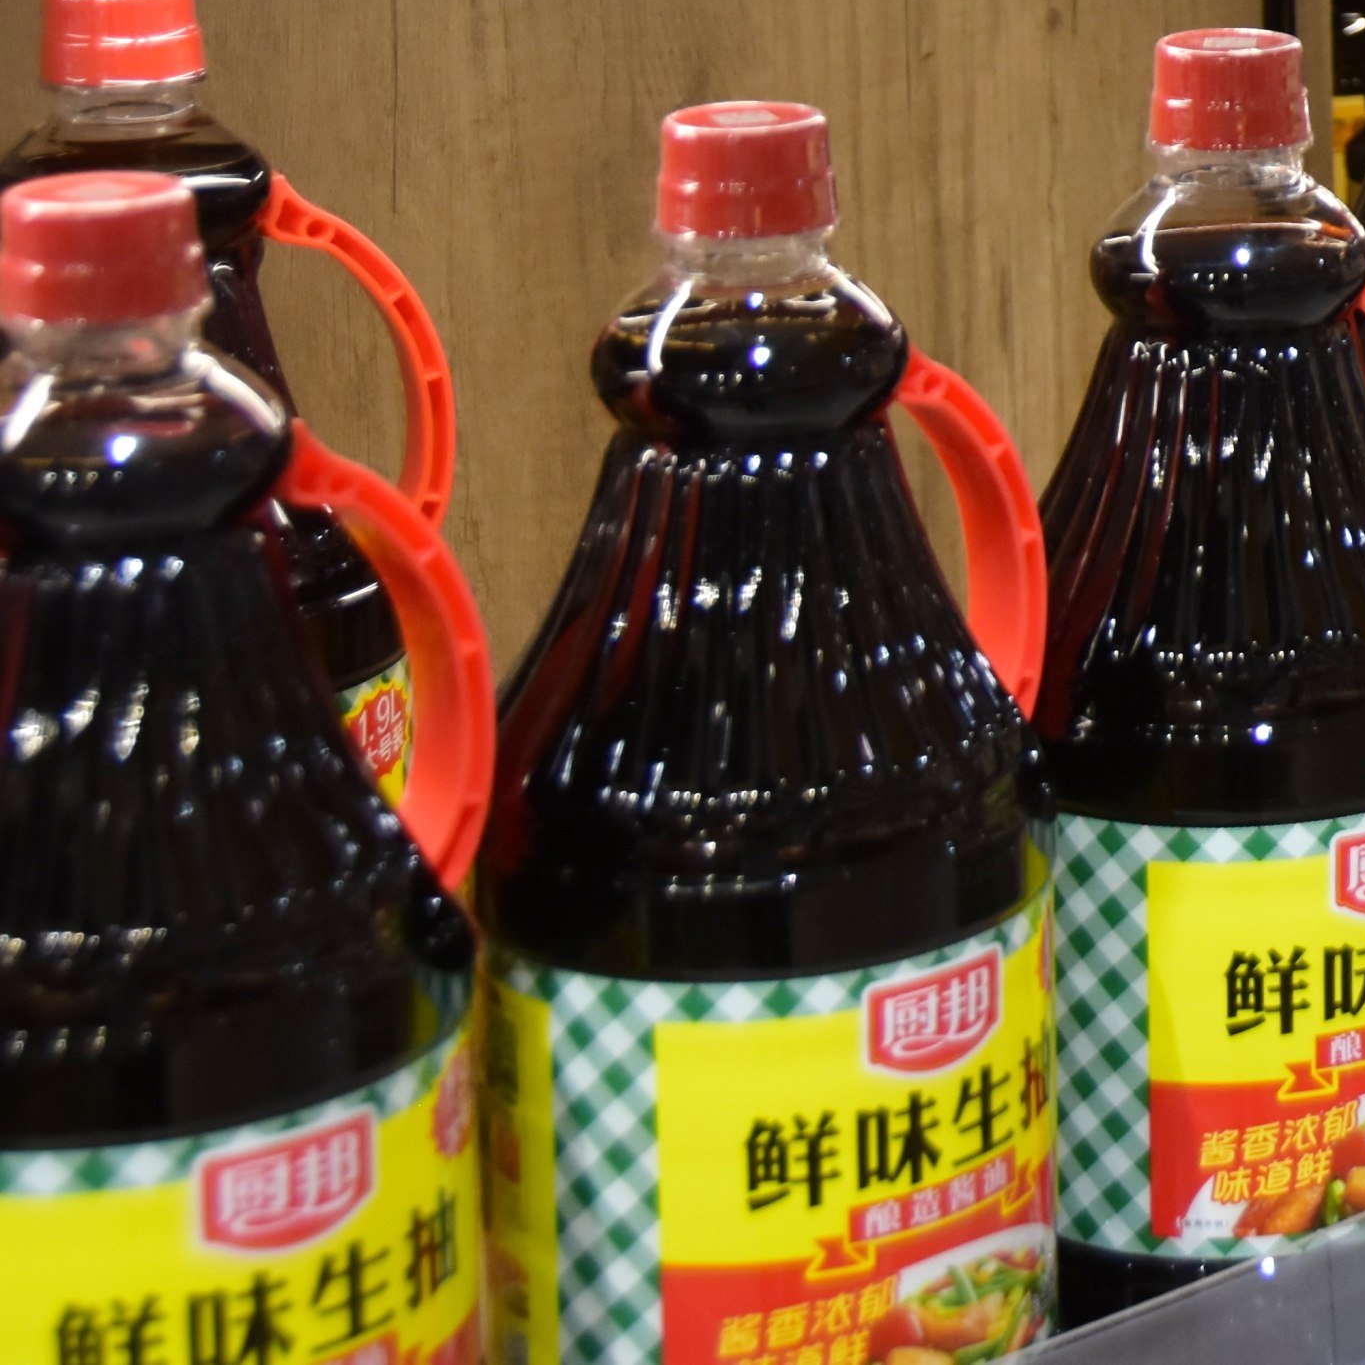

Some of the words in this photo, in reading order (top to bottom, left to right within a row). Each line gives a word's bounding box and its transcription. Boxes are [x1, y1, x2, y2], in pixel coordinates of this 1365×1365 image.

[358, 688, 402, 748] 1.9L
[880, 965, 990, 1059] 厨邦
[1199, 1100, 1360, 1169] 酱香浓郁
[1211, 1146, 1335, 1206] 味道鲜
